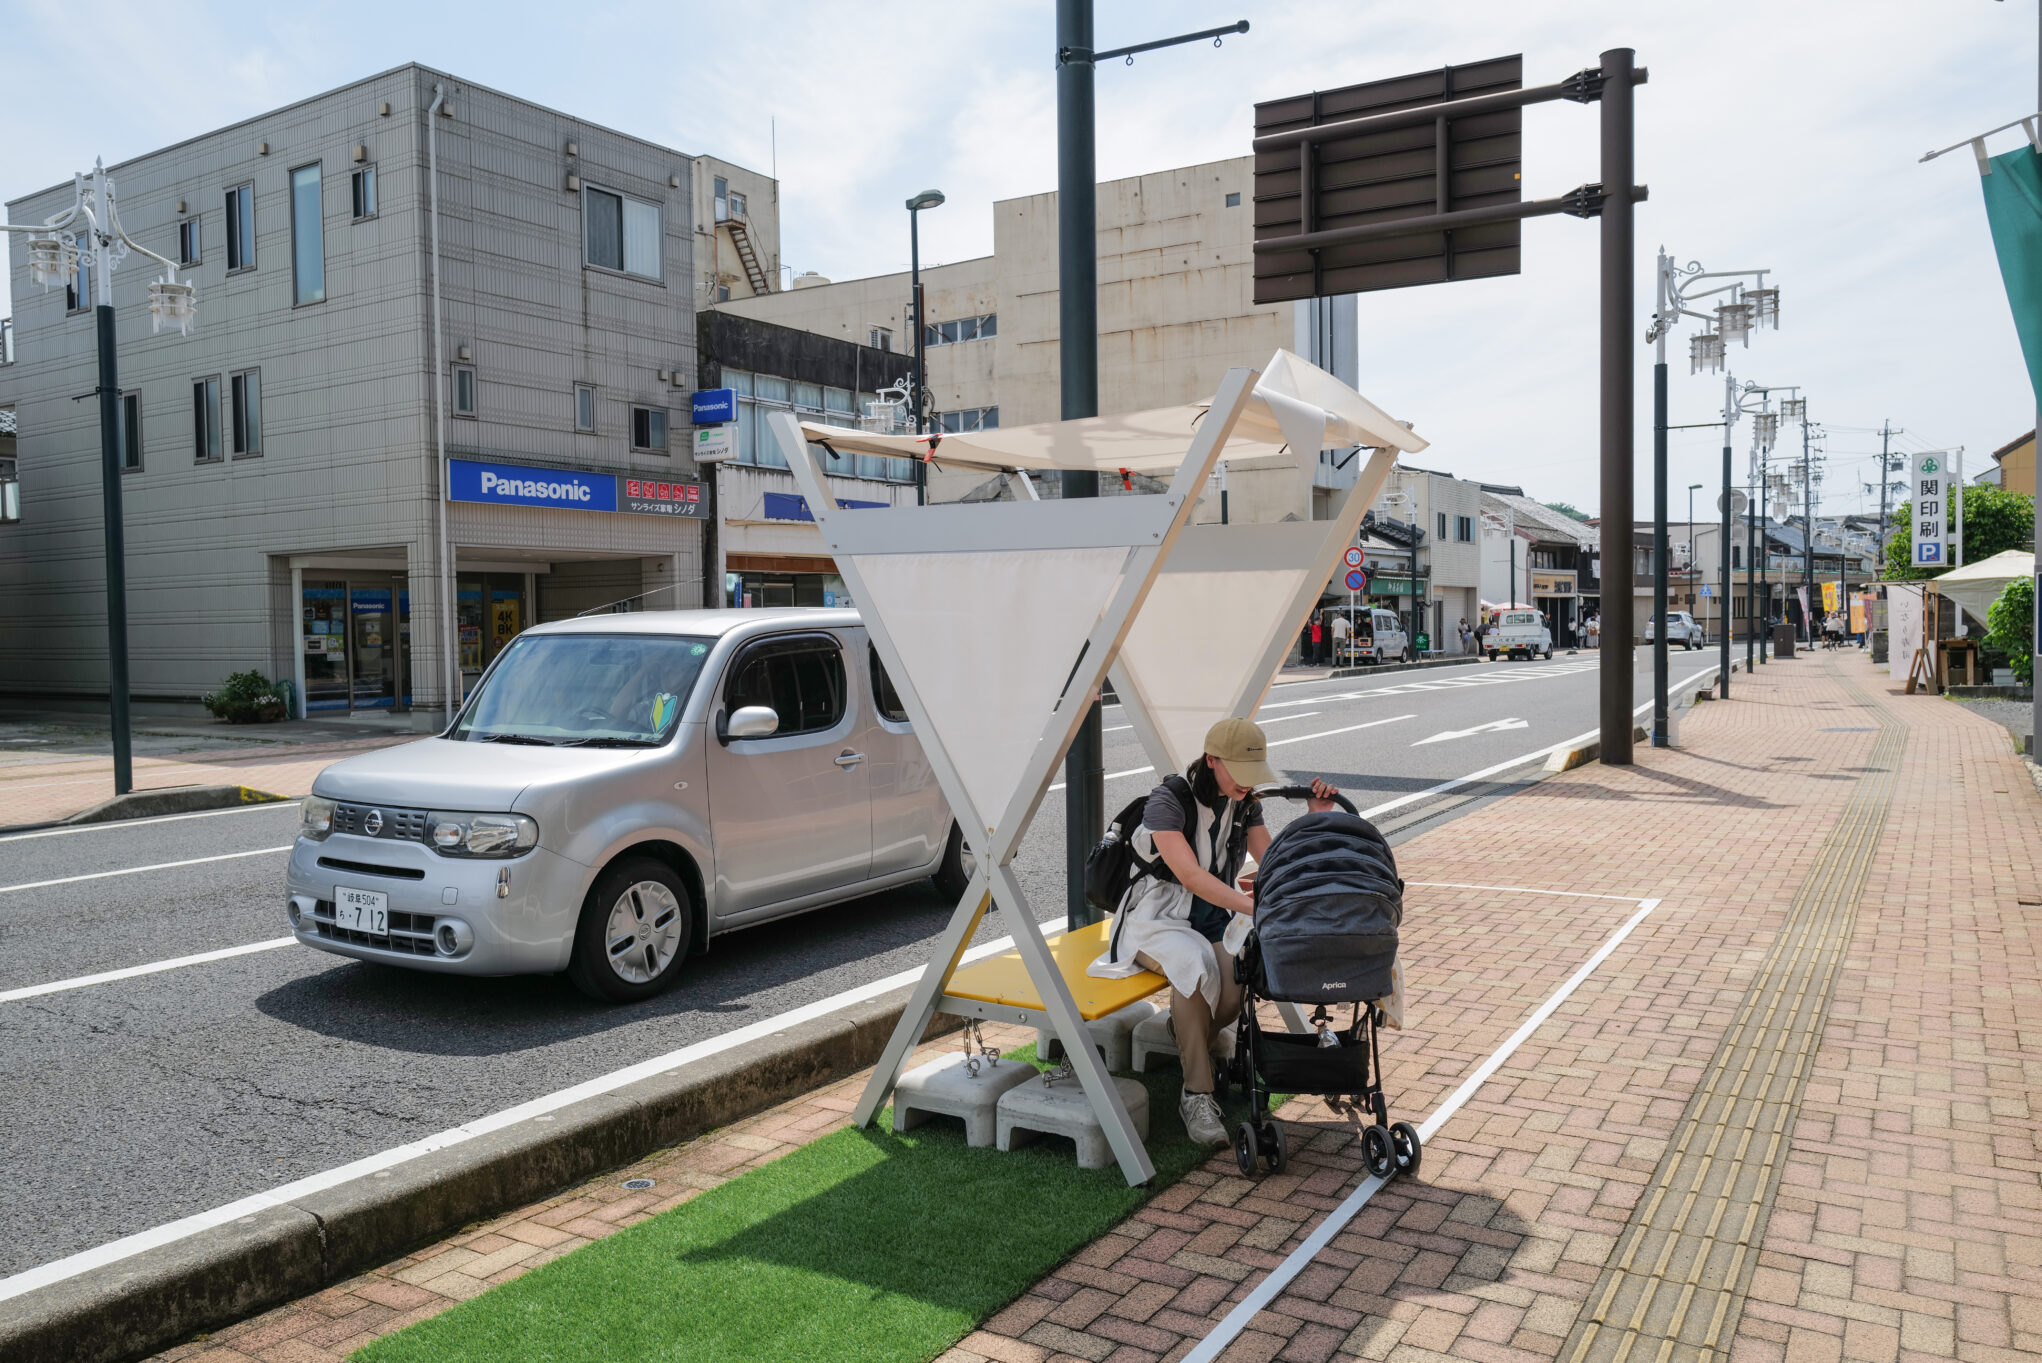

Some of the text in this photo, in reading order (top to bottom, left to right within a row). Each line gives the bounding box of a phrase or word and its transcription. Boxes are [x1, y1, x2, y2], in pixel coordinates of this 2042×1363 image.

[693, 401, 729, 413] Panasonic
[481, 471, 591, 502] Panasonic
[1919, 479, 1939, 538] 関印刷
[1348, 552, 1360, 563] 30
[1922, 544, 1937, 561] P
[353, 601, 385, 609] Panasonic
[497, 610, 513, 622] 4K
[497, 624, 513, 635] 8K
[1321, 981, 1347, 990] Aprica
